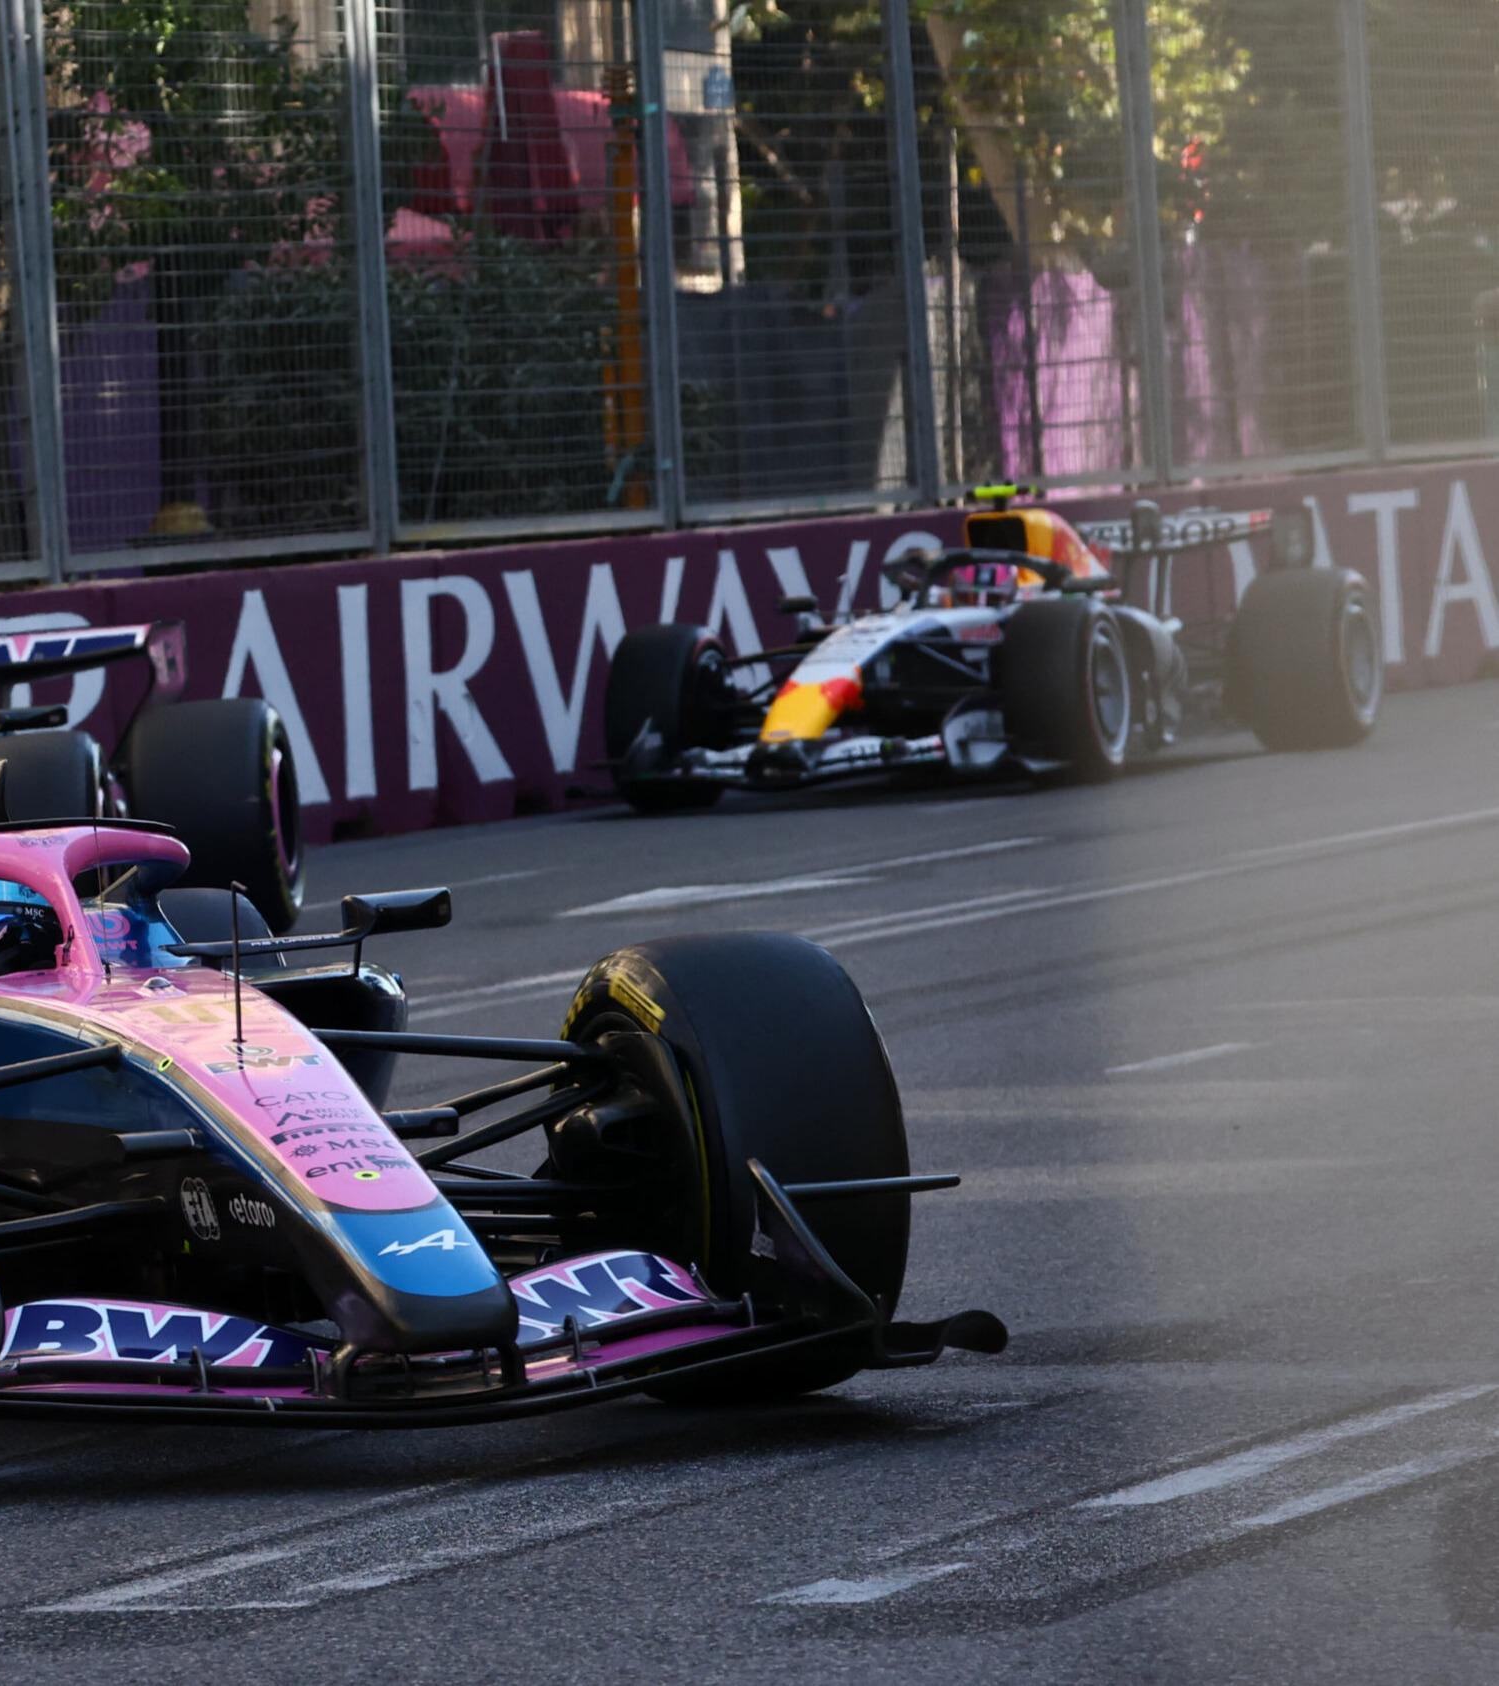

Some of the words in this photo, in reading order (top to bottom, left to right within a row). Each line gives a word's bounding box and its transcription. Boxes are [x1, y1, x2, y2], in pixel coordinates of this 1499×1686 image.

[24, 906, 46, 919] MSC
[204, 1054, 321, 1075] BWT
[254, 1091, 350, 1108] CATO
[305, 1156, 364, 1179] eni
[513, 1252, 707, 1346] WT
[1, 1302, 335, 1368] BWT
